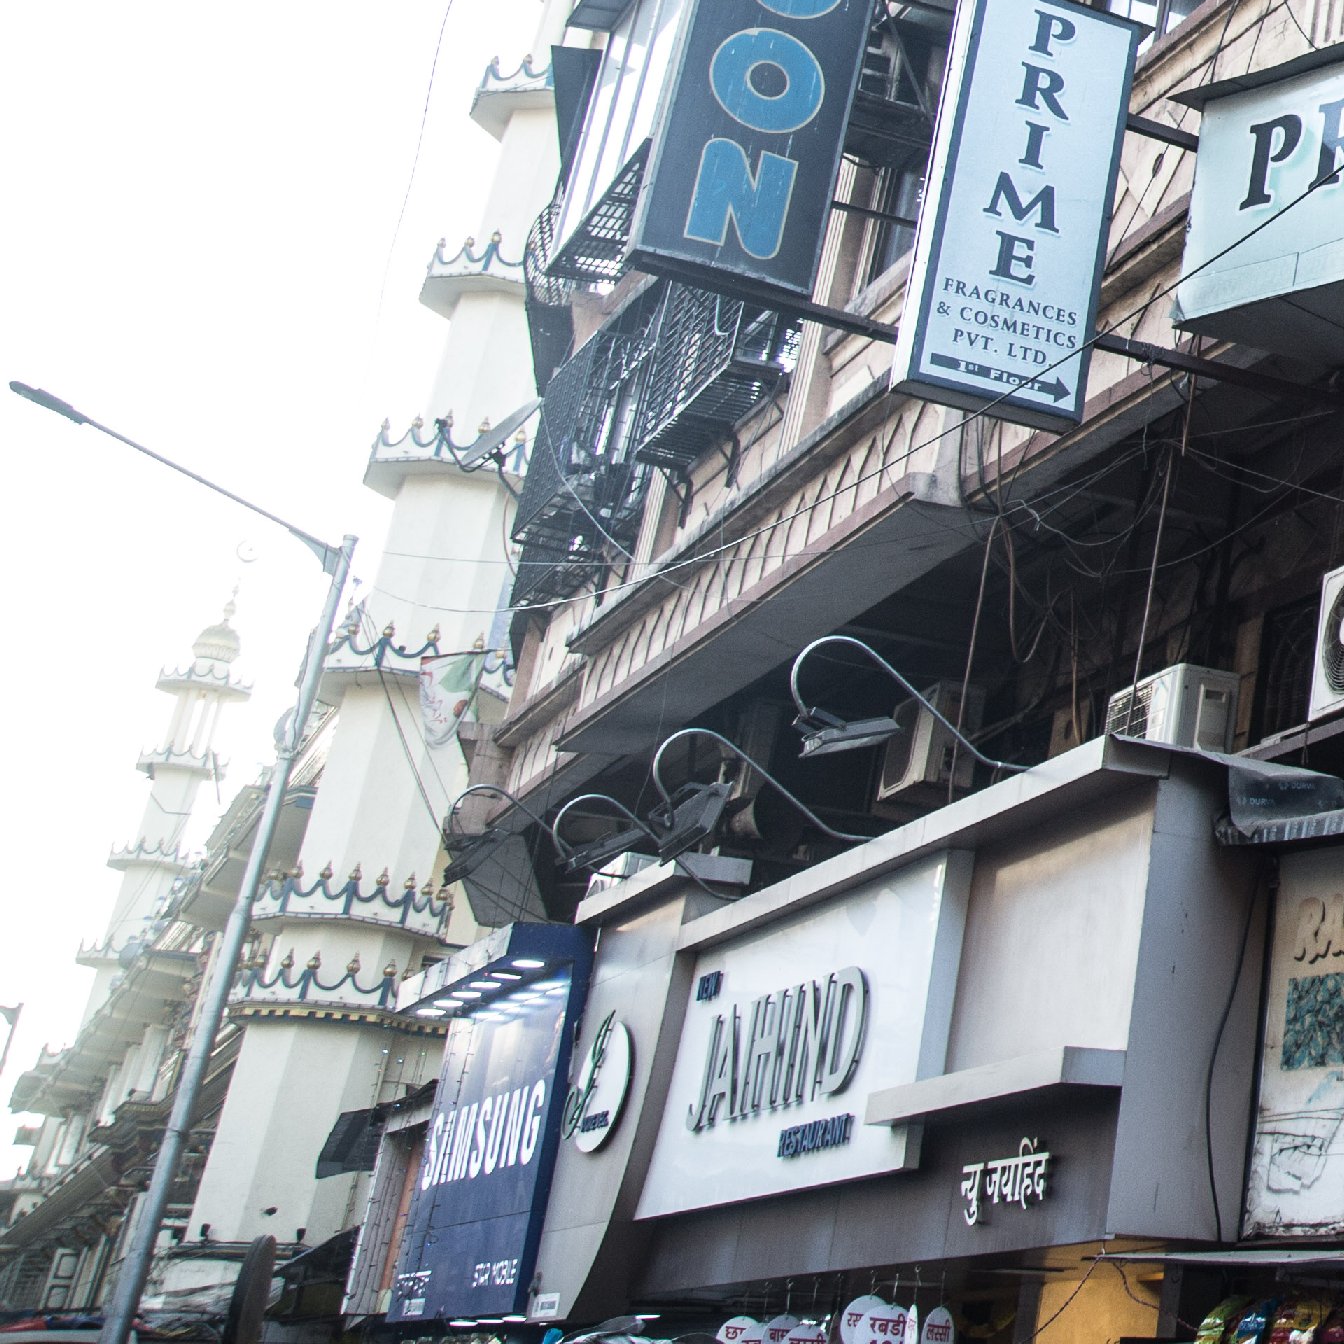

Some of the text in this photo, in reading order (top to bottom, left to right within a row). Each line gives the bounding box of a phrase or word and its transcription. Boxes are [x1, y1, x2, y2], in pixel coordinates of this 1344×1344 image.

[983, 8, 1078, 286] PRIME
[937, 301, 1077, 349] & COSMETICS
[942, 277, 1078, 326] FRAGRANCES
[952, 328, 1053, 367] PVT. LTD.
[989, 370, 1042, 391] Floor
[696, 970, 723, 1003] NEW
[422, 1078, 546, 1191] SAMSUNG
[986, 1136, 1051, 1211] जयहिंद
